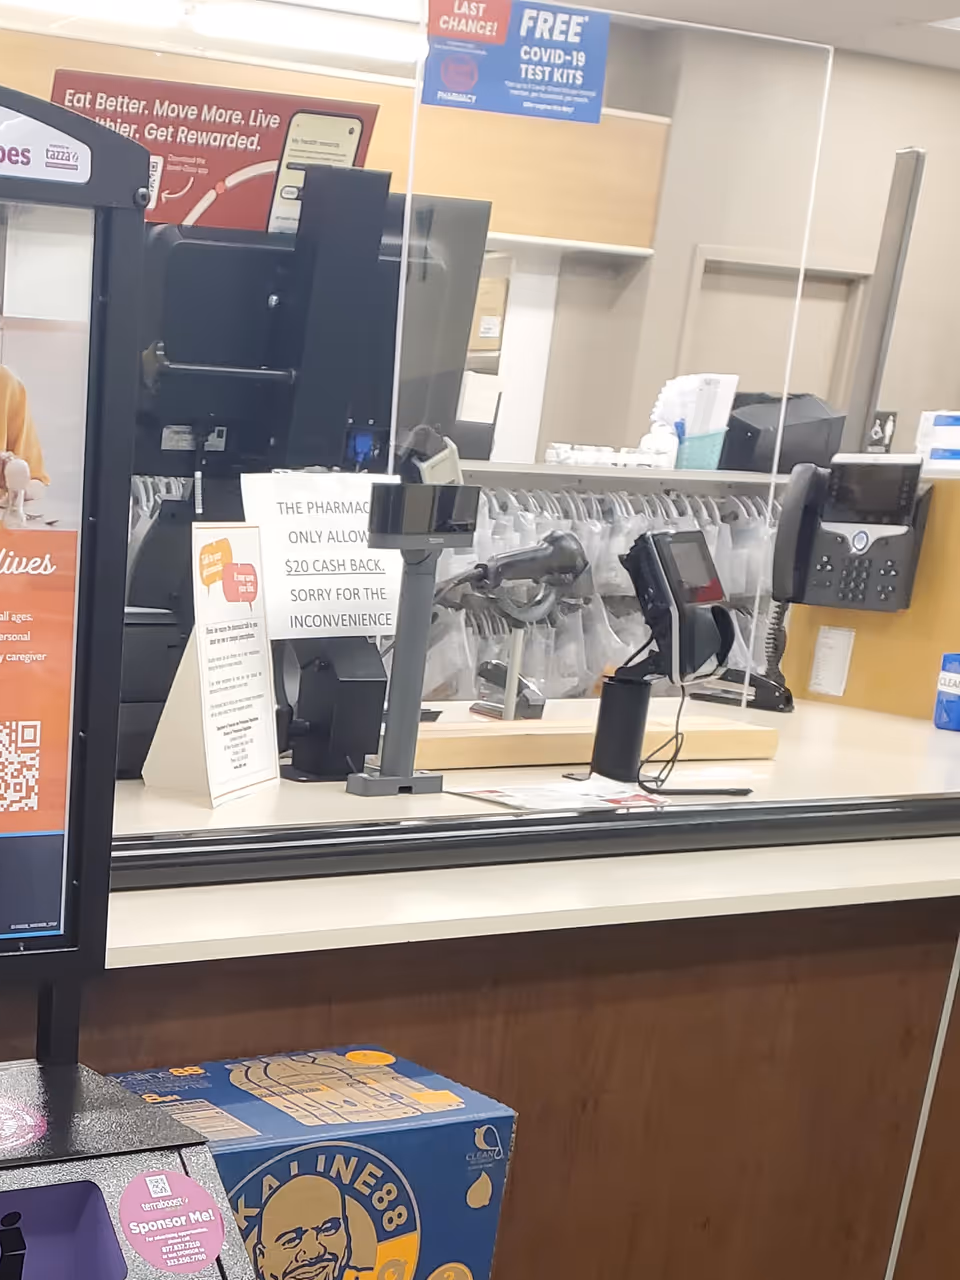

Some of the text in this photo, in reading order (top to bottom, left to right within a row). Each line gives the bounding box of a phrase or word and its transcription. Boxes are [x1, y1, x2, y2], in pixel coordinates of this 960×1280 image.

[454, 0, 486, 16] LAST
[440, 15, 497, 36] CHANCE!
[520, 45, 586, 67] COVID-19
[520, 63, 584, 85] TEST KITS
[64, 89, 281, 128] Eat Better. Move More. Live
[144, 123, 173, 141] Get
[177, 128, 261, 151] Rewarded.
[276, 501, 370, 515] THE PHARMAC
[288, 530, 322, 544] ONLY
[285, 559, 385, 573] $20 CASH BACK.
[290, 587, 387, 602] SORRY FOR THE
[0, 611, 9, 621] all
[11, 613, 33, 623] ages.
[290, 613, 393, 629] INCONVENIENCE
[6, 653, 47, 663] caregiver
[141, 1197, 183, 1211] terraboost
[129, 1208, 216, 1235] Sponsor Me!
